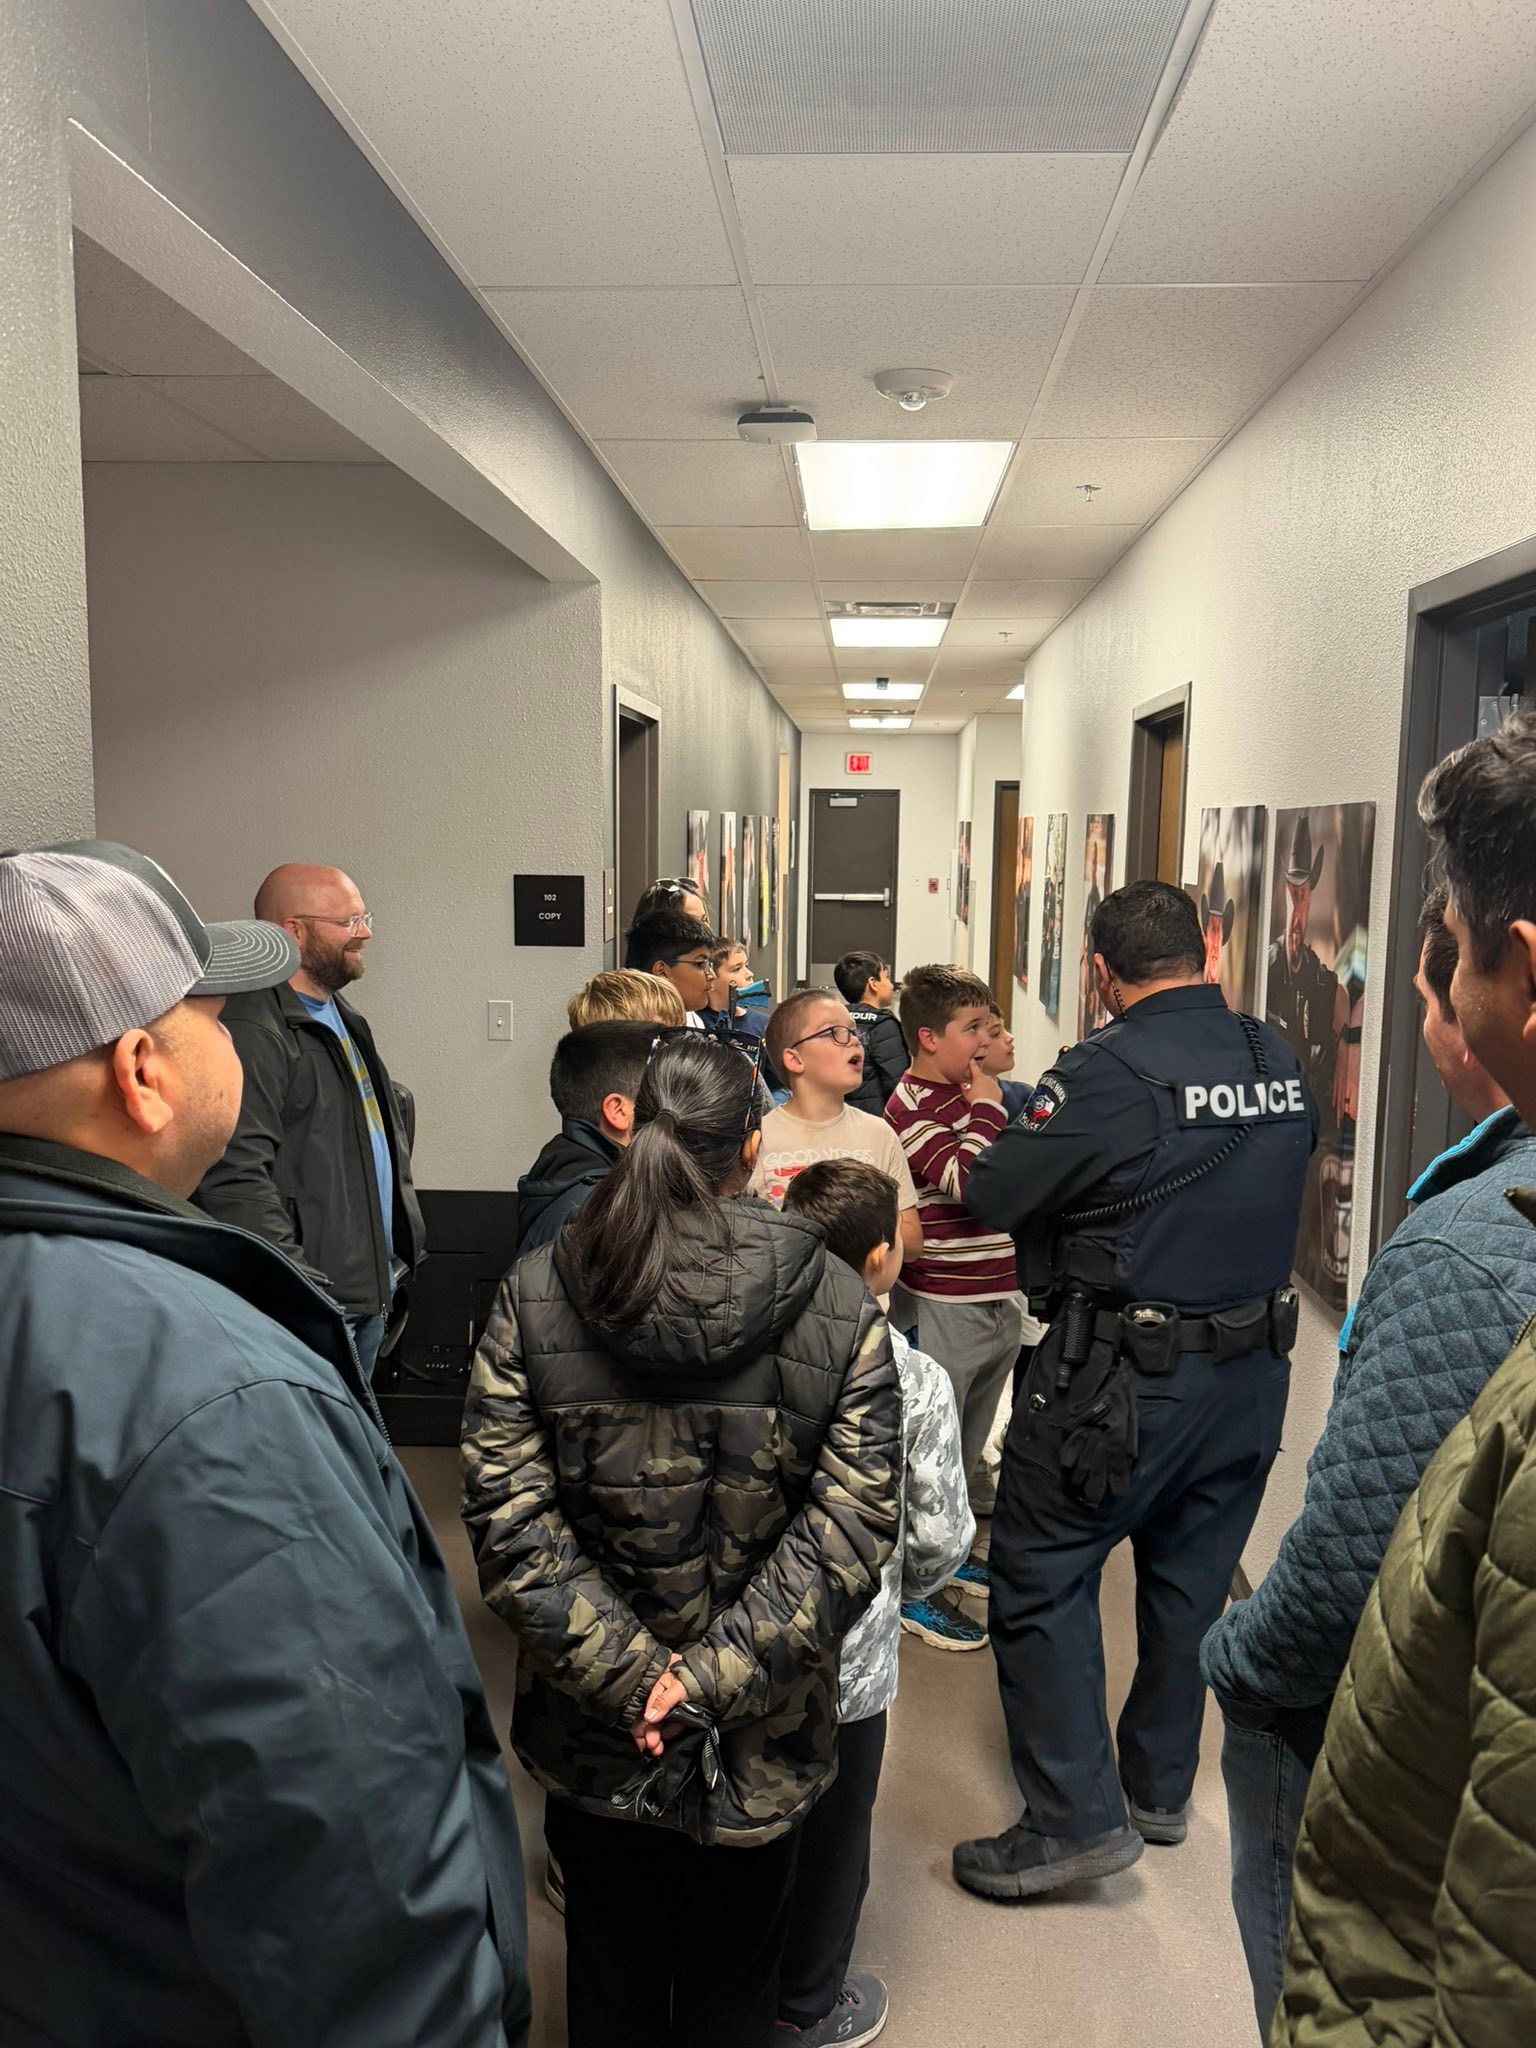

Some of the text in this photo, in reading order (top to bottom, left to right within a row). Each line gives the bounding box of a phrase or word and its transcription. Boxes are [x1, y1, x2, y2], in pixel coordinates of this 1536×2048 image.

[850, 755, 870, 771] EXIT
[543, 893, 557, 901] 102
[538, 912, 562, 920] COPY
[1185, 1079, 1305, 1119] POLICE
[764, 1149, 820, 1175] GOOD
